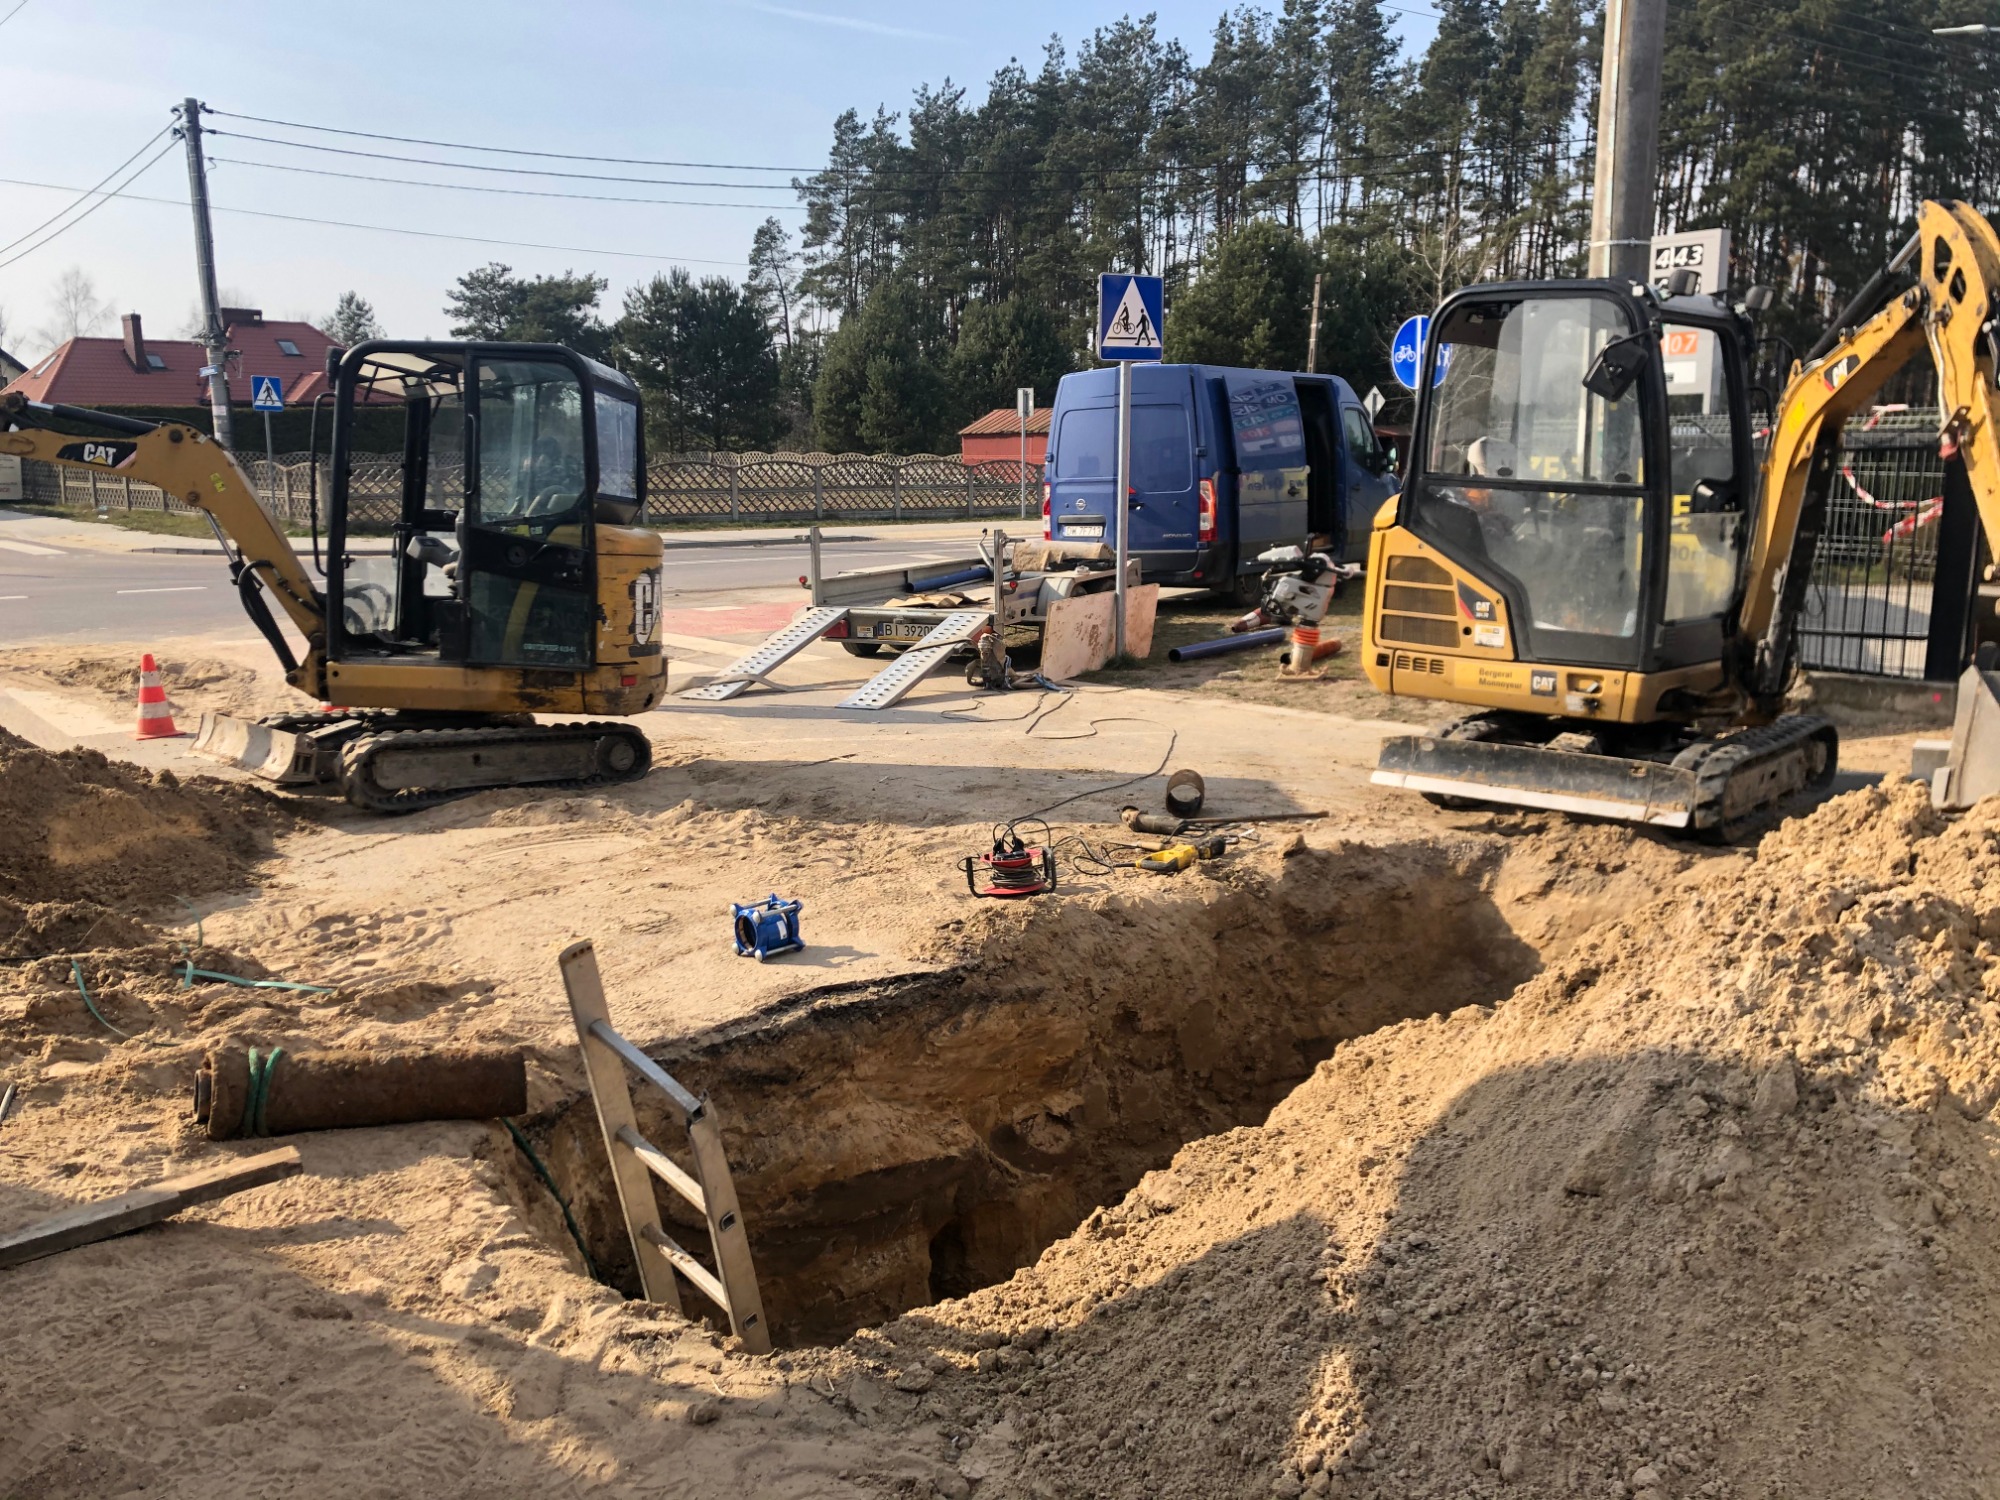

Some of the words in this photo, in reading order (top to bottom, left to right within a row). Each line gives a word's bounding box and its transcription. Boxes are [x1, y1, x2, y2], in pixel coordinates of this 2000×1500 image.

[1832, 357, 1848, 388] CAT
[83, 443, 116, 466] CAT
[1475, 601, 1491, 612] CAT
[885, 624, 898, 636] BI
[1533, 676, 1556, 692] CAT
